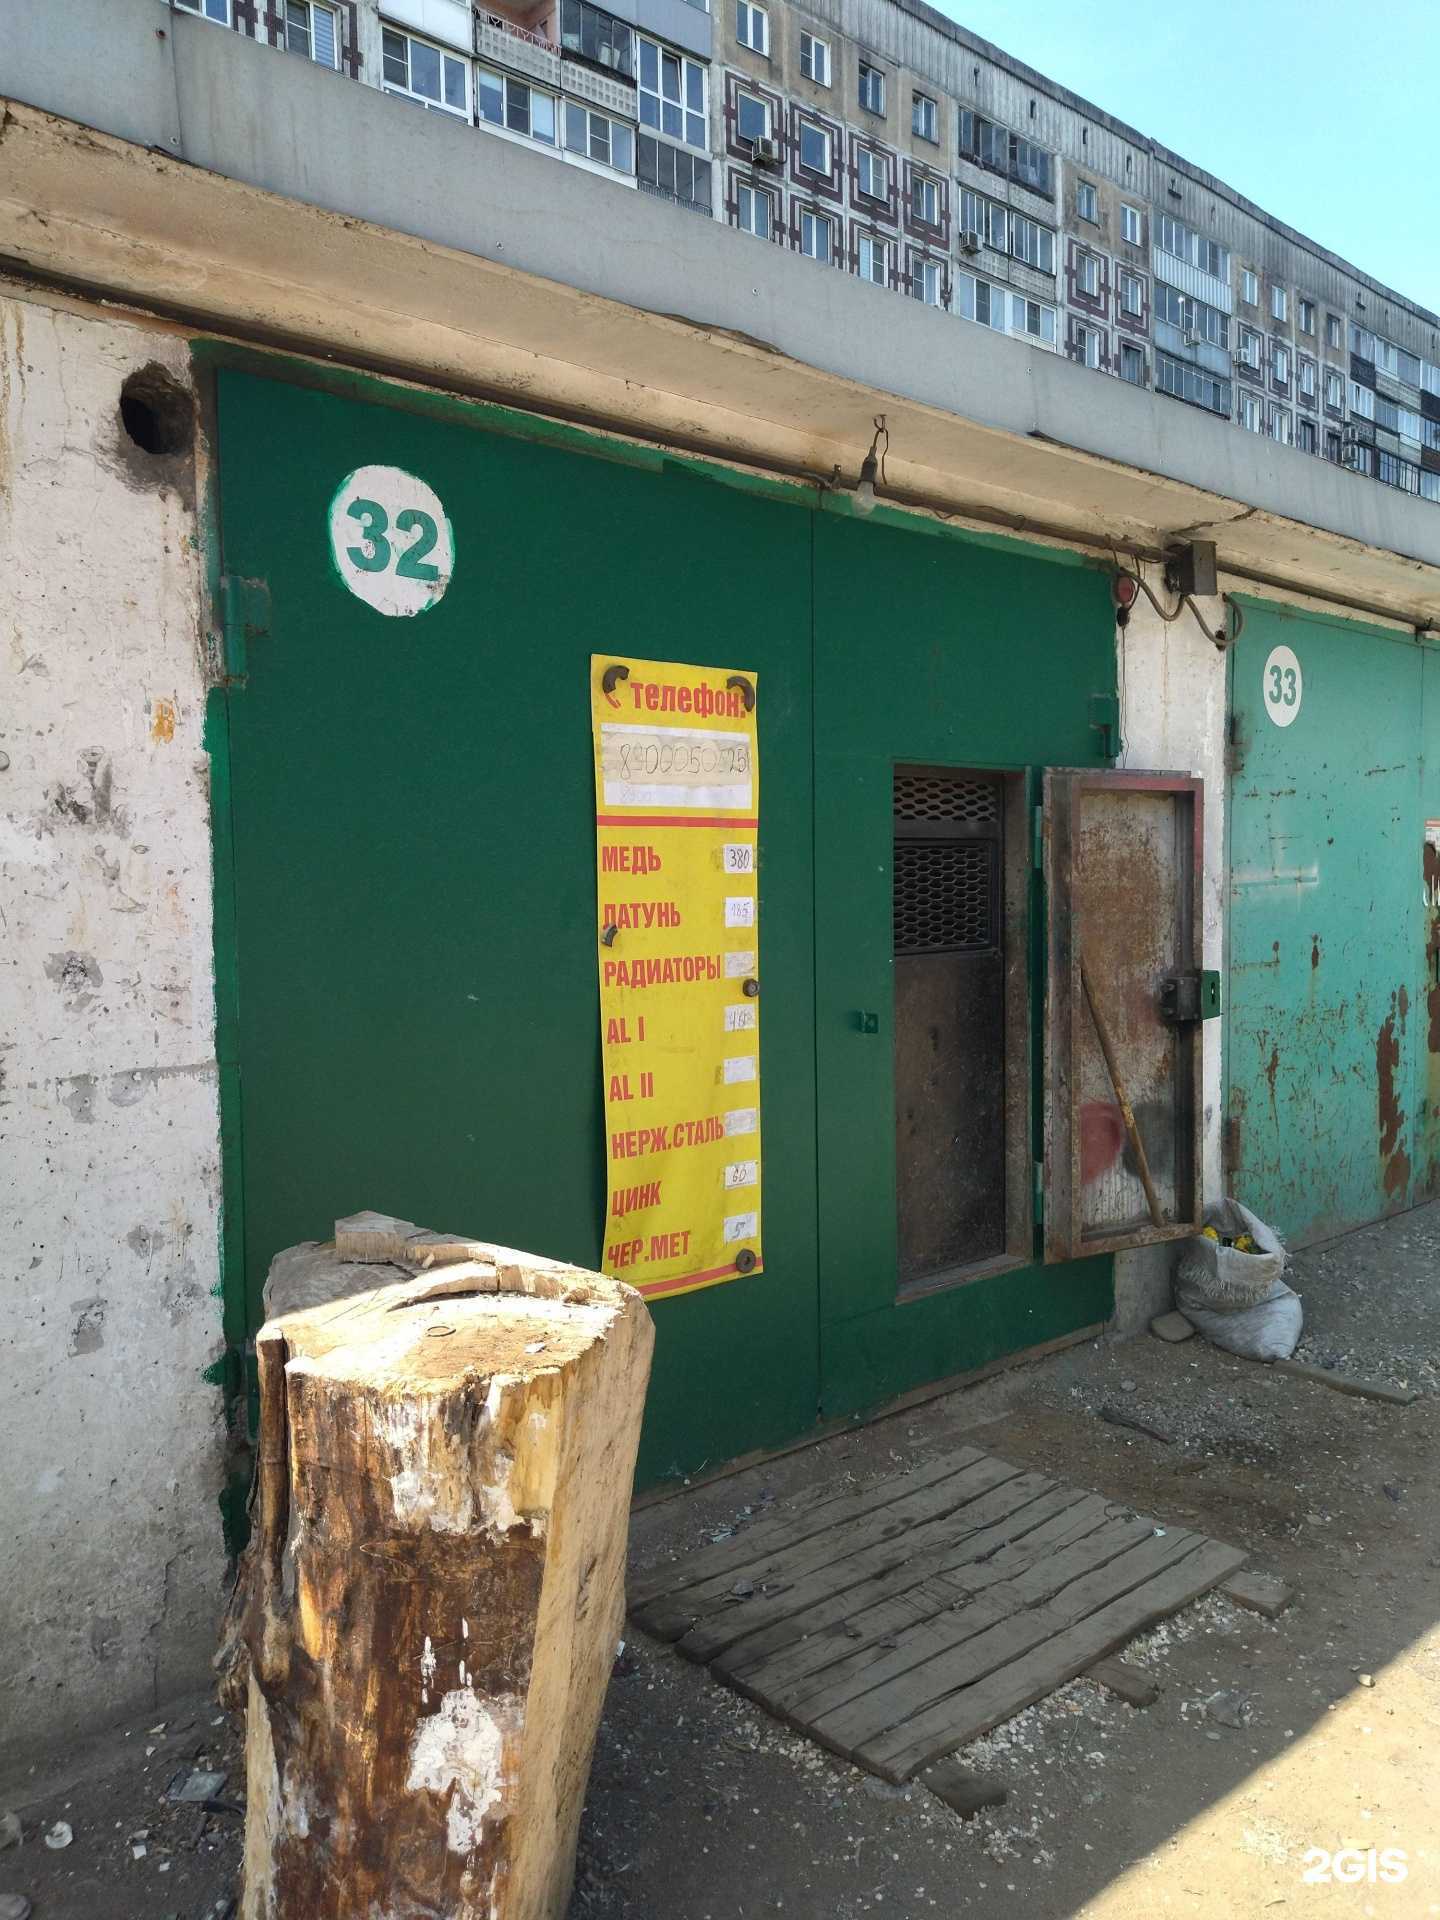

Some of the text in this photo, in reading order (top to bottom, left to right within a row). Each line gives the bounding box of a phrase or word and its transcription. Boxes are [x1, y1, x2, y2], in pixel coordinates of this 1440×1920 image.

[346, 498, 439, 582] 32
[1268, 664, 1297, 706] 33
[601, 846, 662, 875] МЕДЬ
[603, 954, 721, 988] РАДИАТОРЫ
[607, 1018, 632, 1044] AL
[609, 1074, 634, 1102] AL
[611, 1115, 725, 1159] НЕРЖ.СТАЛЬ
[611, 1181, 662, 1217] ЦИНК
